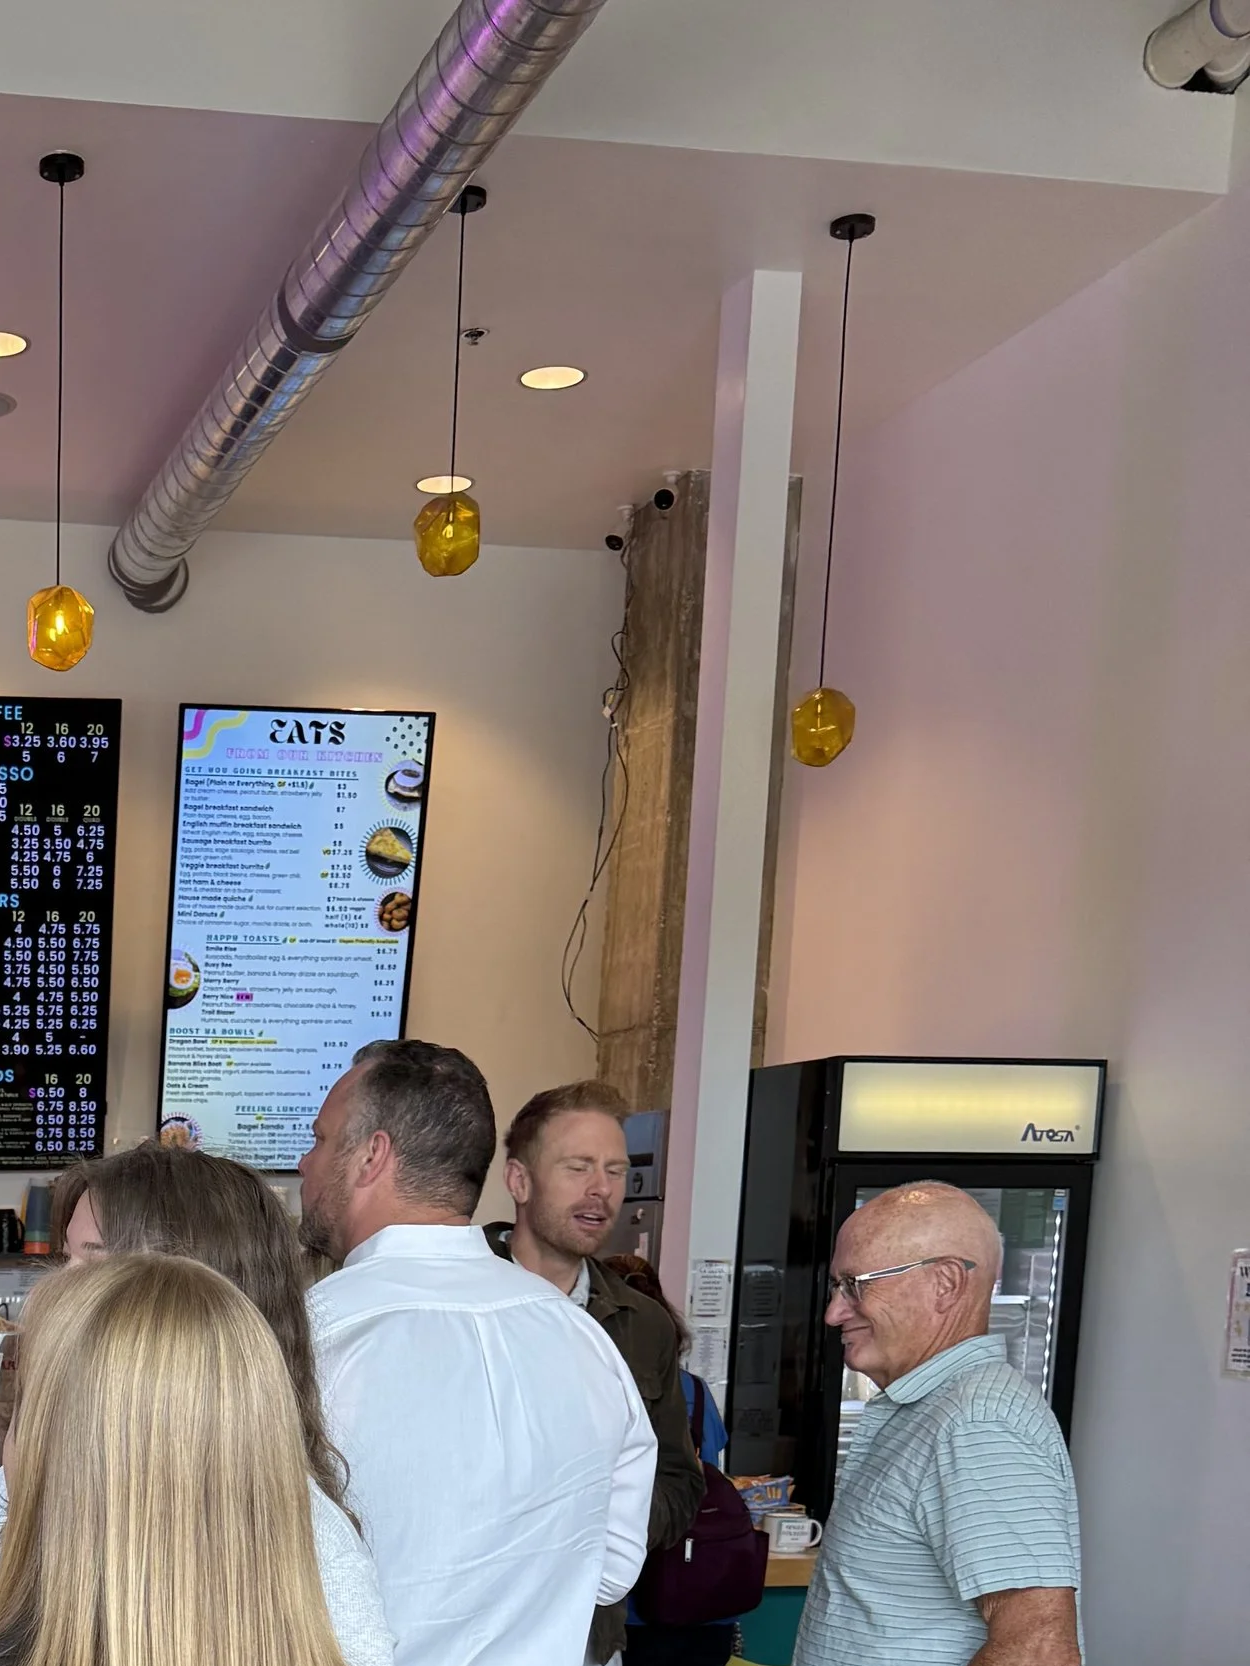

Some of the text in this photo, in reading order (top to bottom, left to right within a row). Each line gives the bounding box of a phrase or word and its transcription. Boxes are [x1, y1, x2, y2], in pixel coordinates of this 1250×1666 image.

[20, 723, 104, 735] 12 16 20
[269, 718, 346, 745] EATS
[4, 736, 41, 747] $3.25
[47, 737, 76, 748] 3.60
[79, 737, 108, 748] 3.95
[233, 767, 263, 775] GOING
[267, 769, 324, 777] BREAKFAST
[19, 805, 100, 817] 12 16 20
[185, 803, 274, 812] Bagel breakfast sandwich
[182, 820, 208, 829] English
[233, 821, 267, 829] breakfast
[268, 822, 302, 830] sandwich
[11, 825, 40, 836] 4.50
[77, 826, 105, 837] 6.25
[11, 839, 39, 849] 3.25
[43, 839, 71, 850] 3.50
[76, 839, 104, 850] 4.75
[182, 838, 212, 846] Sausage
[213, 838, 247, 846] breakfast
[11, 852, 39, 862] 4.25
[43, 852, 71, 863] 4.75
[11, 865, 39, 876] 5.50
[76, 866, 103, 877] 7.25
[180, 862, 205, 870] Veggie
[10, 879, 39, 889] 5.50
[76, 879, 102, 890] 7.25
[39, 924, 66, 935] 4.75
[73, 924, 100, 935] 5.75
[3, 938, 32, 948] 4.50
[38, 938, 66, 949] 5.50
[72, 938, 100, 949] 6.75
[243, 935, 280, 943] TOASTS
[4, 951, 31, 961] 5.50
[38, 951, 65, 961] 6.50
[73, 951, 99, 962] 7.75
[4, 964, 30, 975] 3.75
[37, 965, 65, 975] 4.50
[72, 965, 99, 975] 5.50
[3, 977, 30, 987] 4.75
[37, 977, 65, 987] 5.50
[71, 977, 99, 987] 6.50
[37, 992, 63, 1002] 4.75
[71, 992, 98, 1002] 5.50
[3, 1006, 30, 1016] 5.25
[36, 1005, 63, 1016] 5.75
[70, 1005, 97, 1016] 6.25
[2, 1019, 30, 1029] 4.25
[36, 1019, 63, 1029] 5.25
[70, 1019, 97, 1029] 6.25
[2, 1045, 29, 1055] 3.90
[35, 1045, 62, 1055] 5.25
[68, 1045, 96, 1055] 6.60
[45, 1074, 58, 1084] 16
[76, 1074, 91, 1084] 20
[29, 1087, 65, 1098] $6.50
[37, 1102, 63, 1112] 6.75
[68, 1101, 96, 1112] 8.50
[36, 1115, 64, 1125] 6.50
[68, 1115, 95, 1125] 8.25
[36, 1128, 63, 1138] 6.75
[68, 1128, 95, 1138] 8.50
[35, 1141, 62, 1151] 6.50
[68, 1141, 95, 1151] 8.25
